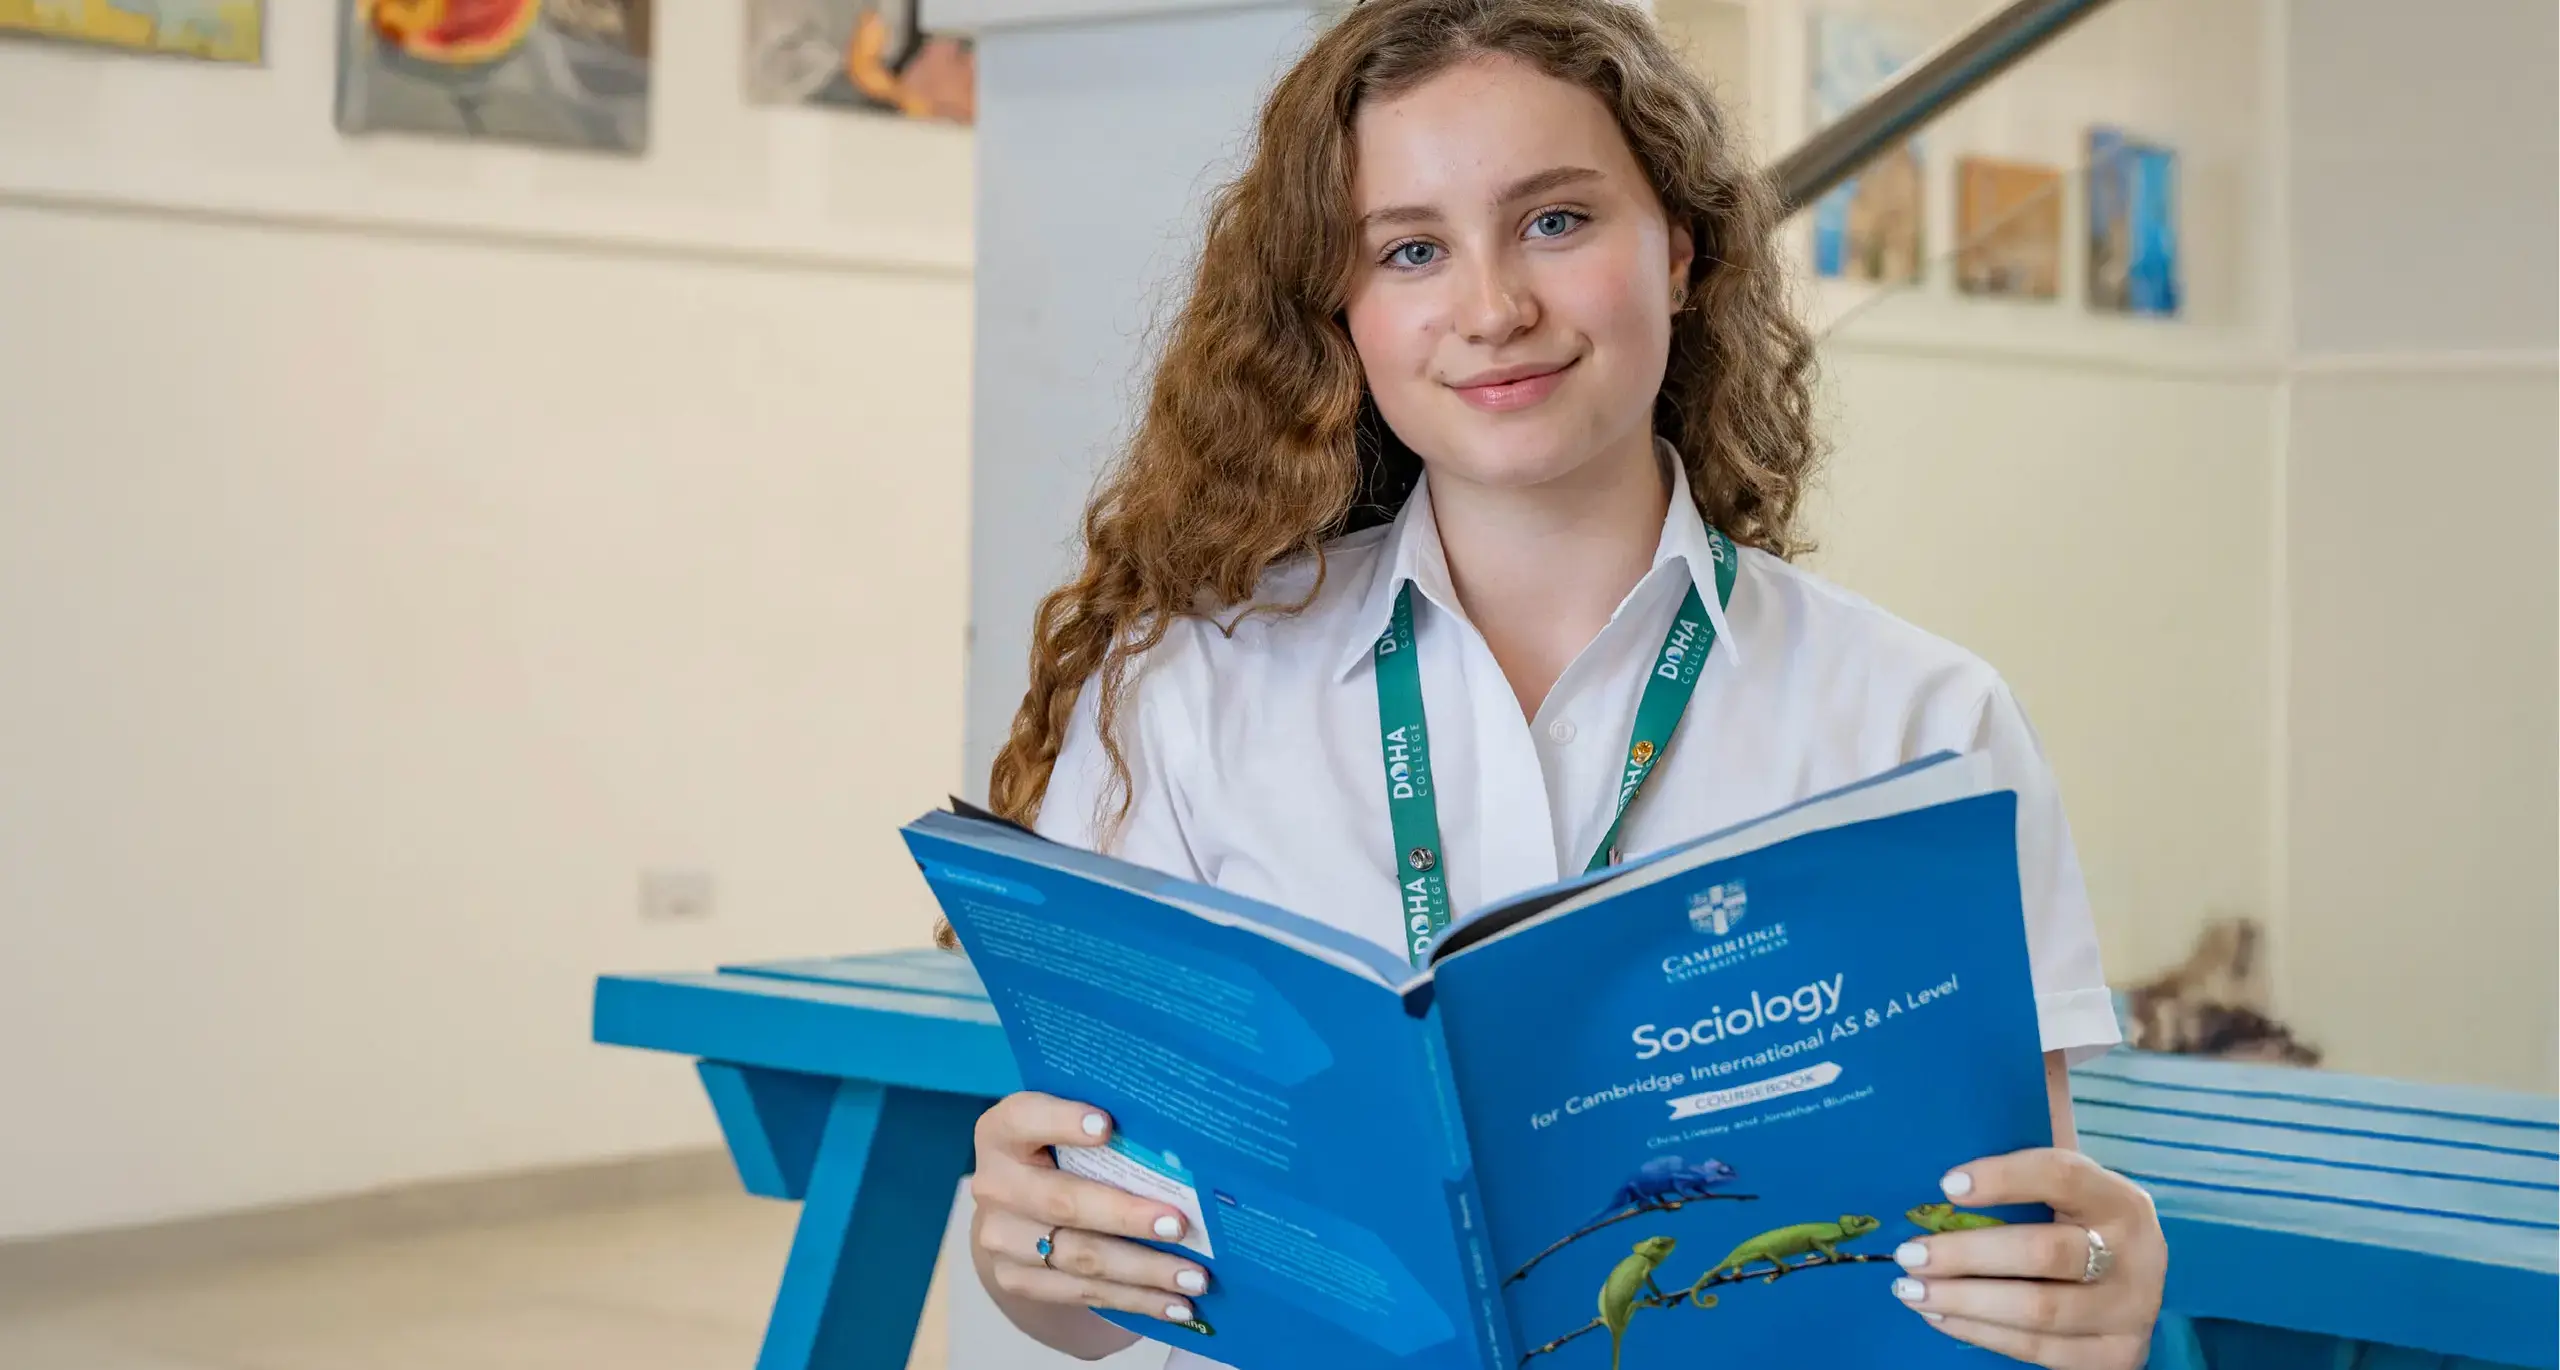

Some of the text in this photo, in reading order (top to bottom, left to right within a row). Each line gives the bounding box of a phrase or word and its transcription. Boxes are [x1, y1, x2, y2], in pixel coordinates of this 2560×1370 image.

[1657, 619, 1699, 680] DOHA
[1681, 627, 1711, 684] COLLEGE
[1386, 726, 1413, 799] DOHA
[1410, 724, 1427, 797] COLLEGE
[1405, 877, 1432, 955] DOHA
[1430, 876, 1446, 926] LLEGE
[1662, 922, 1787, 974] CAMBRIDGE
[1631, 972, 1844, 1060] Sociology
[1530, 974, 1959, 1130] for Cambridge International AS & A Level
[1694, 1072, 1816, 1111] COURSEBOOK
[1734, 1116, 1758, 1129] and
[1763, 1103, 1820, 1123] Jonathan
